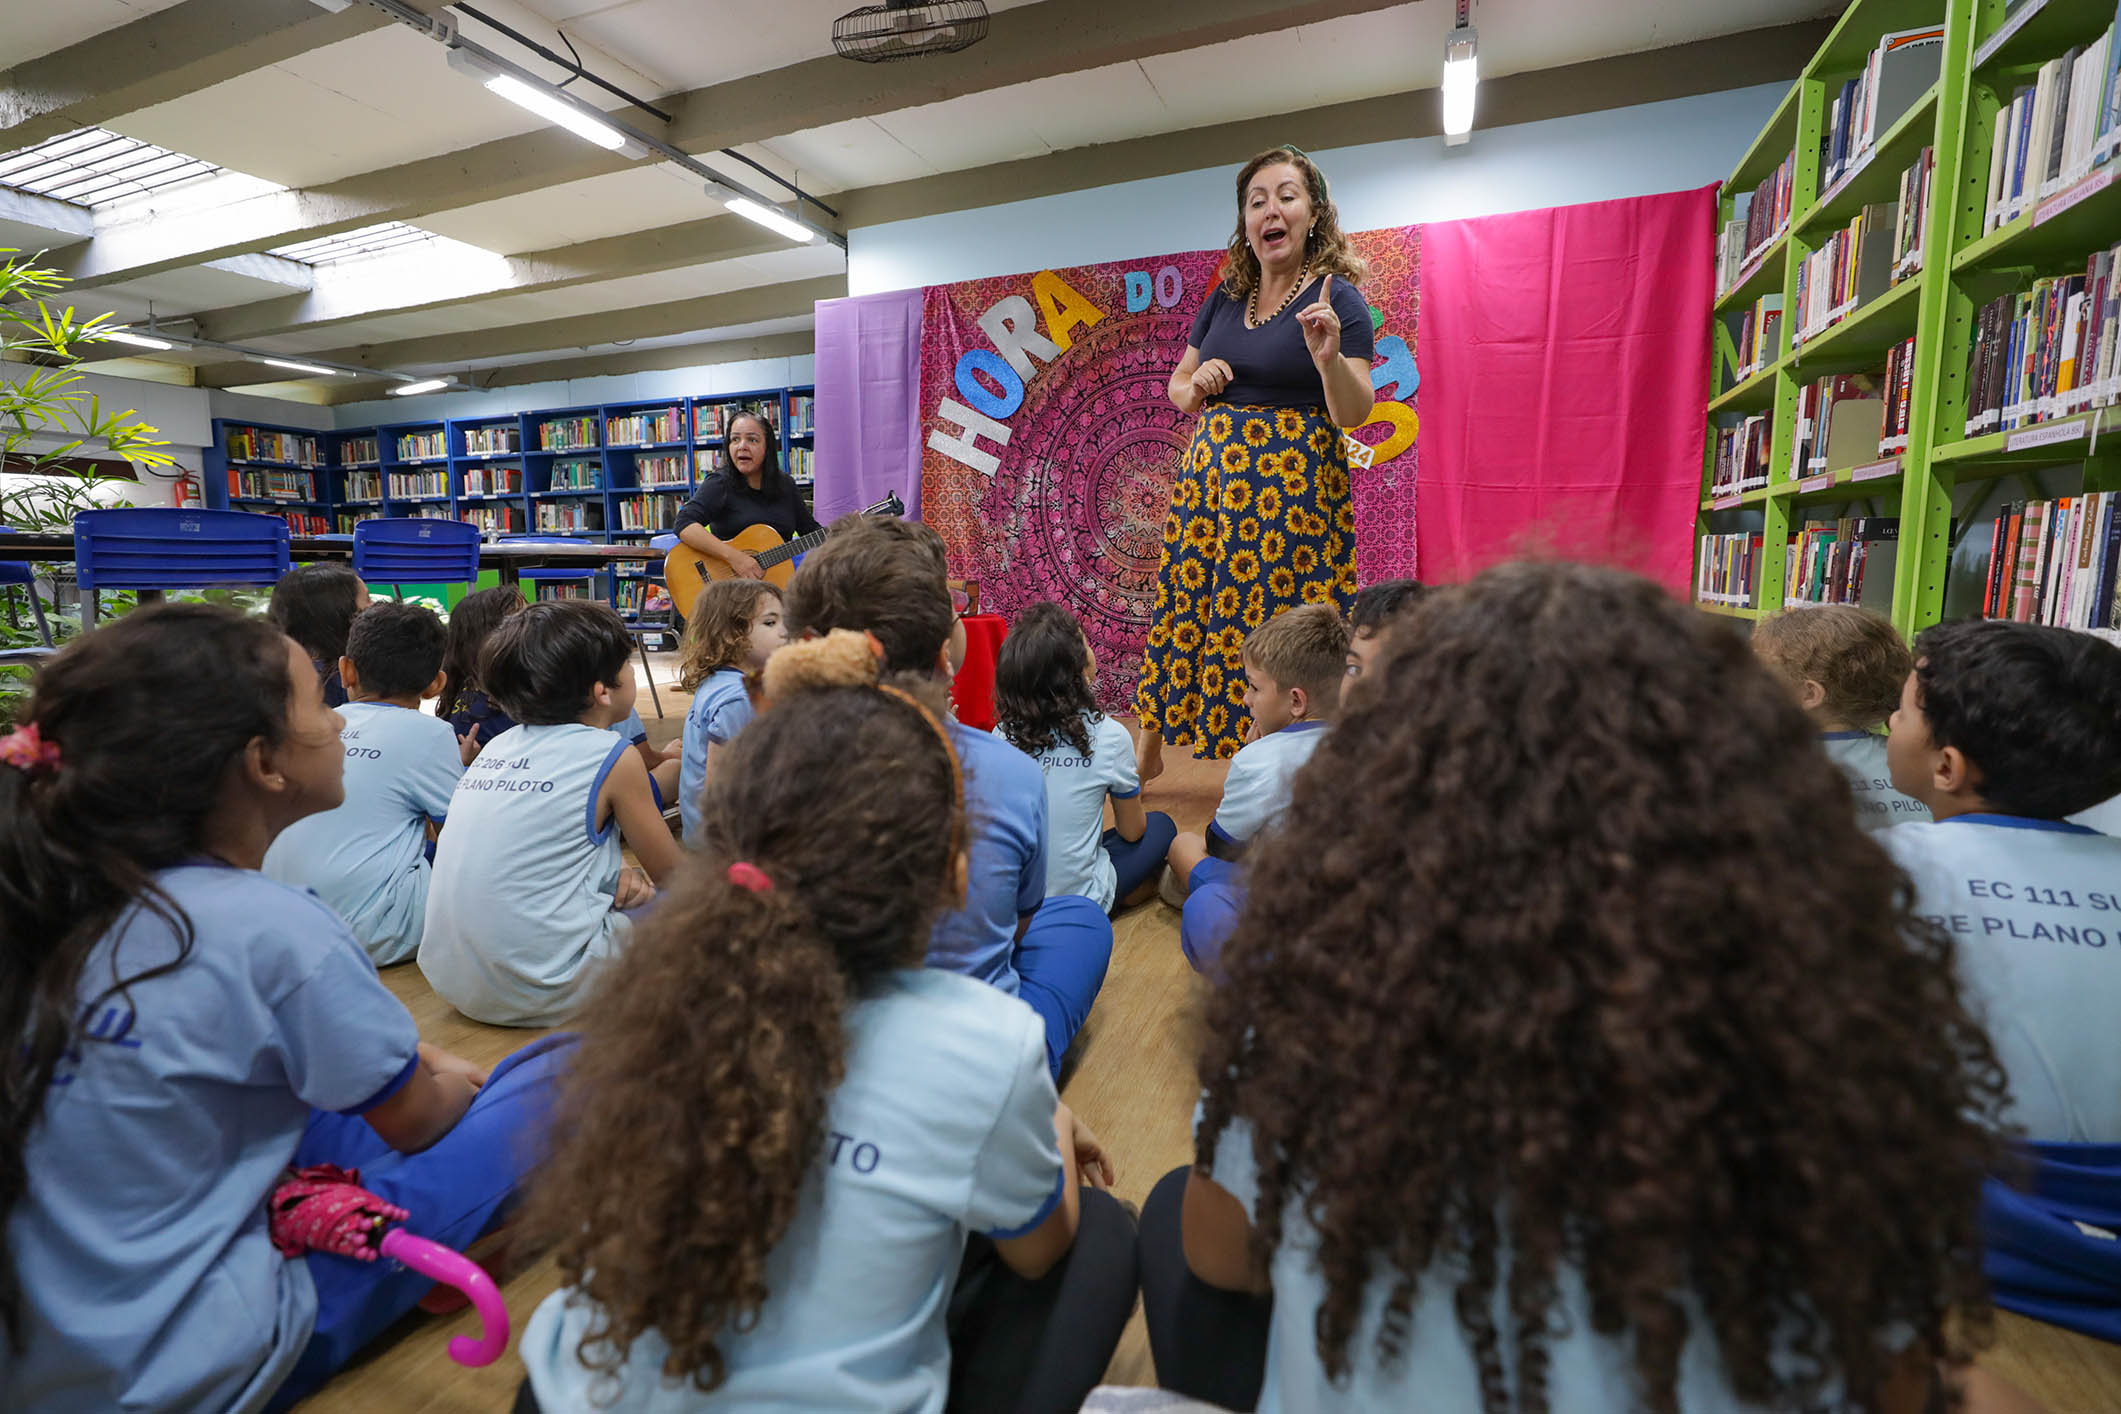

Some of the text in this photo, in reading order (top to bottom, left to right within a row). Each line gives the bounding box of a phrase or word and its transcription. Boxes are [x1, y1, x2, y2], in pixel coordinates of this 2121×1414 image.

[927, 268, 1105, 477] HORA
[1124, 265, 1182, 312] DO
[340, 730, 360, 740] UL
[346, 747, 382, 760] OTO
[481, 759, 505, 770] 206
[1042, 757, 1092, 768] PILOTO
[494, 780, 554, 793] PILOTO
[1873, 778, 1894, 790] SU
[1968, 879, 2121, 913] EC 111 SU
[1926, 915, 1973, 934] RE
[1982, 916, 2107, 948] PLANO
